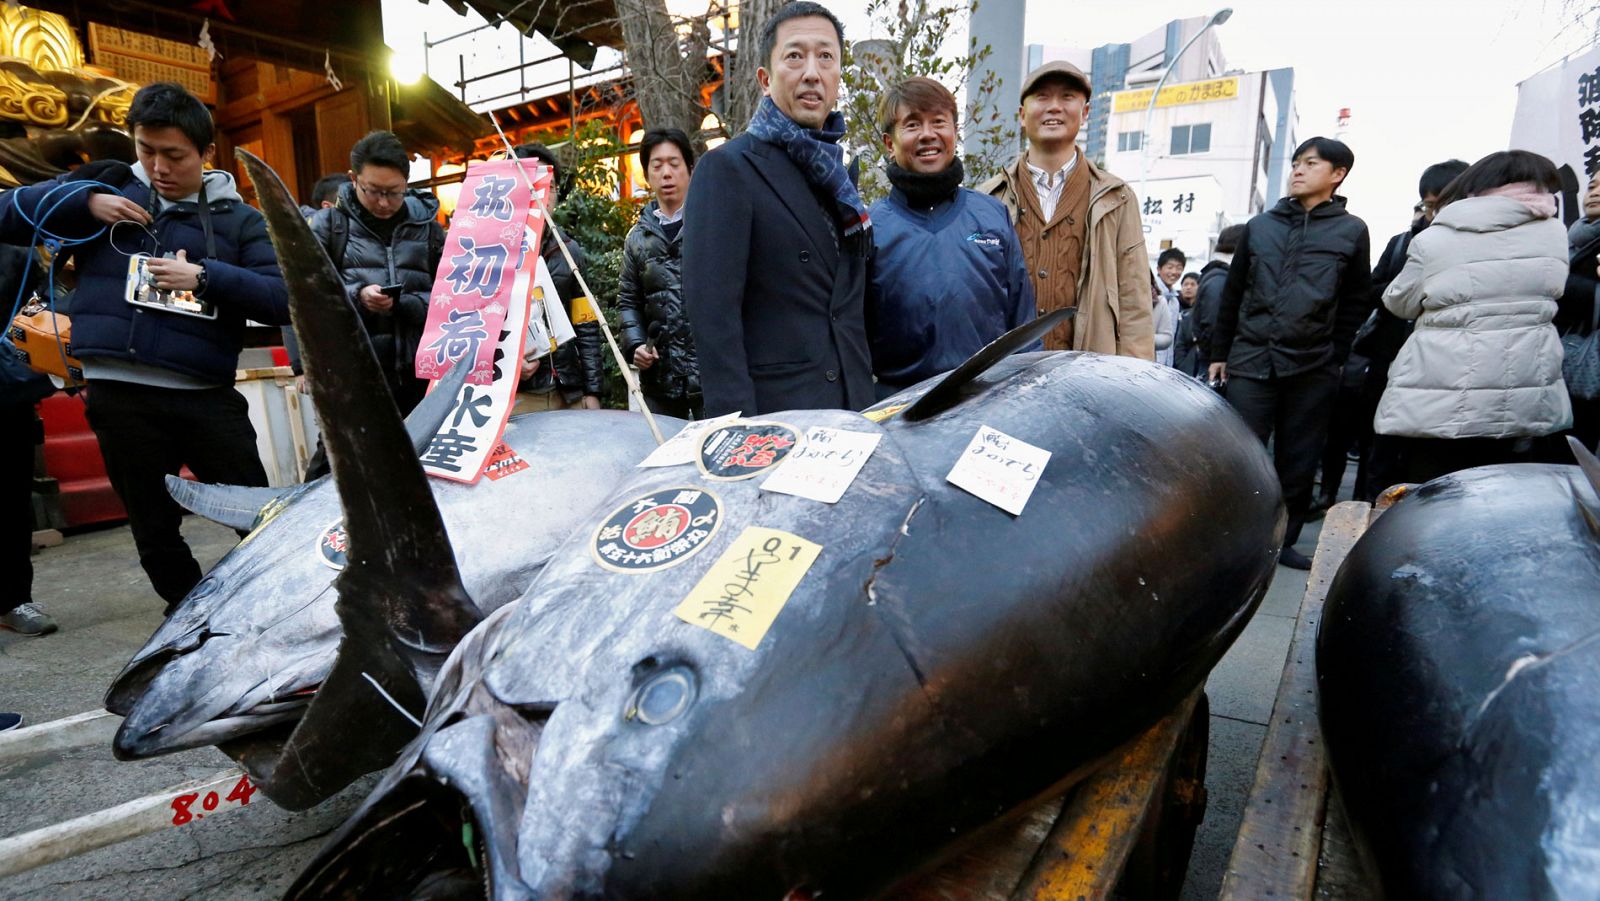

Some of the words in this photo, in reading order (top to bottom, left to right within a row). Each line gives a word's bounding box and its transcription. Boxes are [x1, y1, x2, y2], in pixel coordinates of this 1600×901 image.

[1143, 193, 1195, 215] 松村
[427, 176, 515, 371] 祝初荷
[629, 508, 684, 545] 鮪
